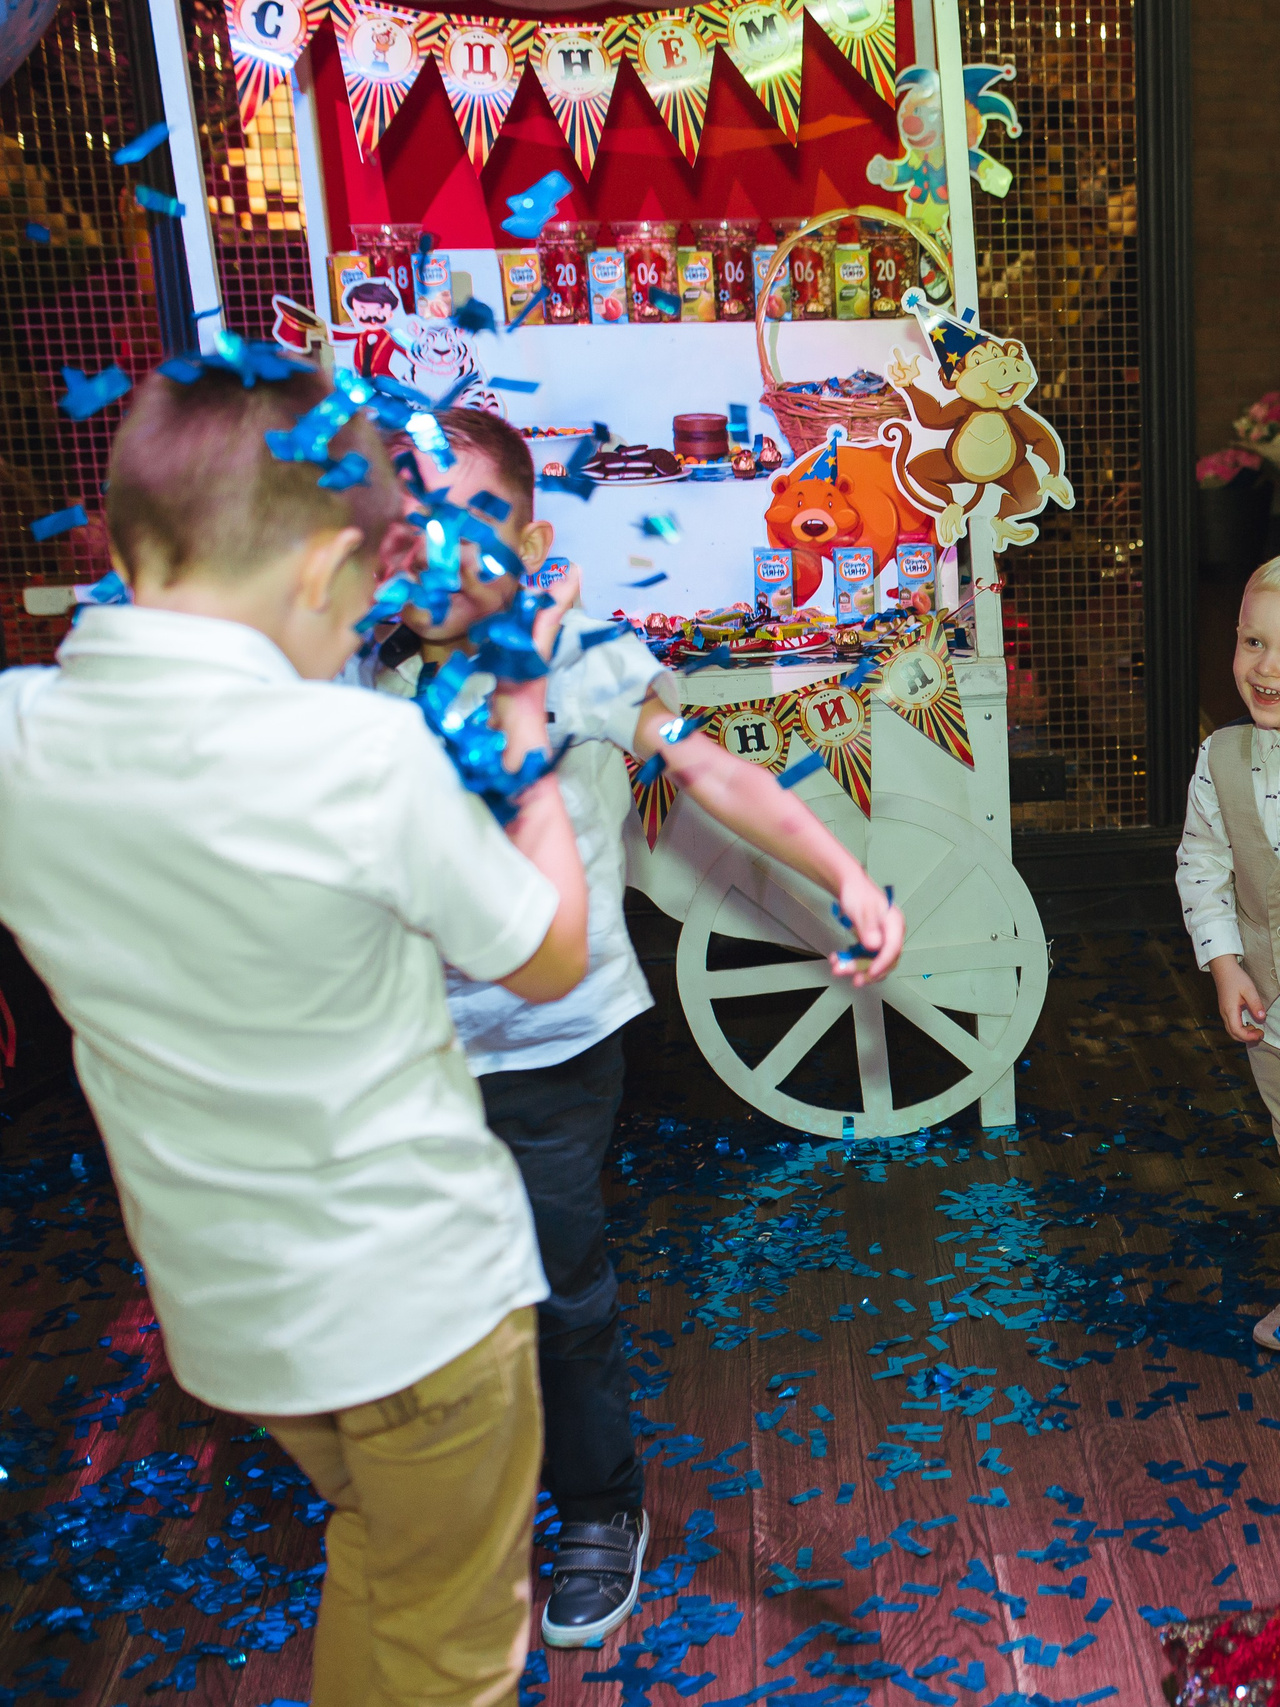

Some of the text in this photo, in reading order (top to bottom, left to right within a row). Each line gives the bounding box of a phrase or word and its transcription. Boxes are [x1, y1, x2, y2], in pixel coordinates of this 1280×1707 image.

[387, 265, 409, 289] 18
[555, 262, 577, 287] 20
[637, 262, 659, 285] 06
[724, 260, 745, 283] 06
[794, 260, 815, 283] 06
[875, 258, 897, 282] 20
